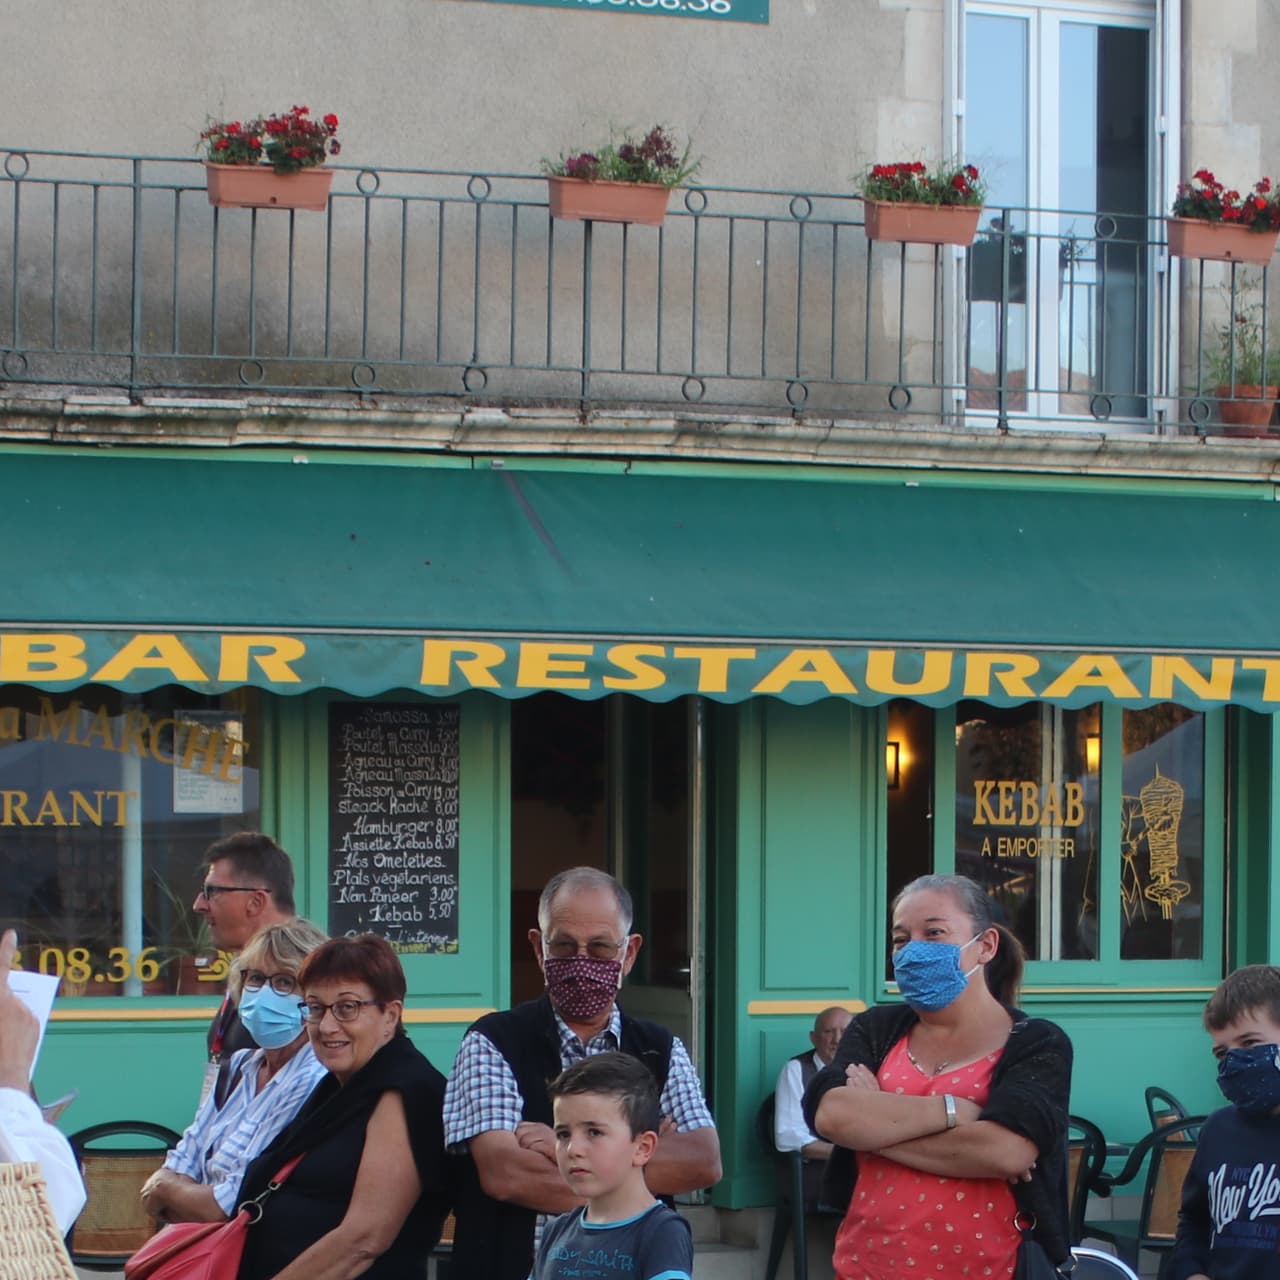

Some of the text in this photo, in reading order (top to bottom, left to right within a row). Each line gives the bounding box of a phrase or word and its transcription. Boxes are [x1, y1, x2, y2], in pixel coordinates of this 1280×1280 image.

[972, 780, 1085, 827] KEBAB
[349, 815, 434, 836] Hamburger
[981, 837, 992, 857] A
